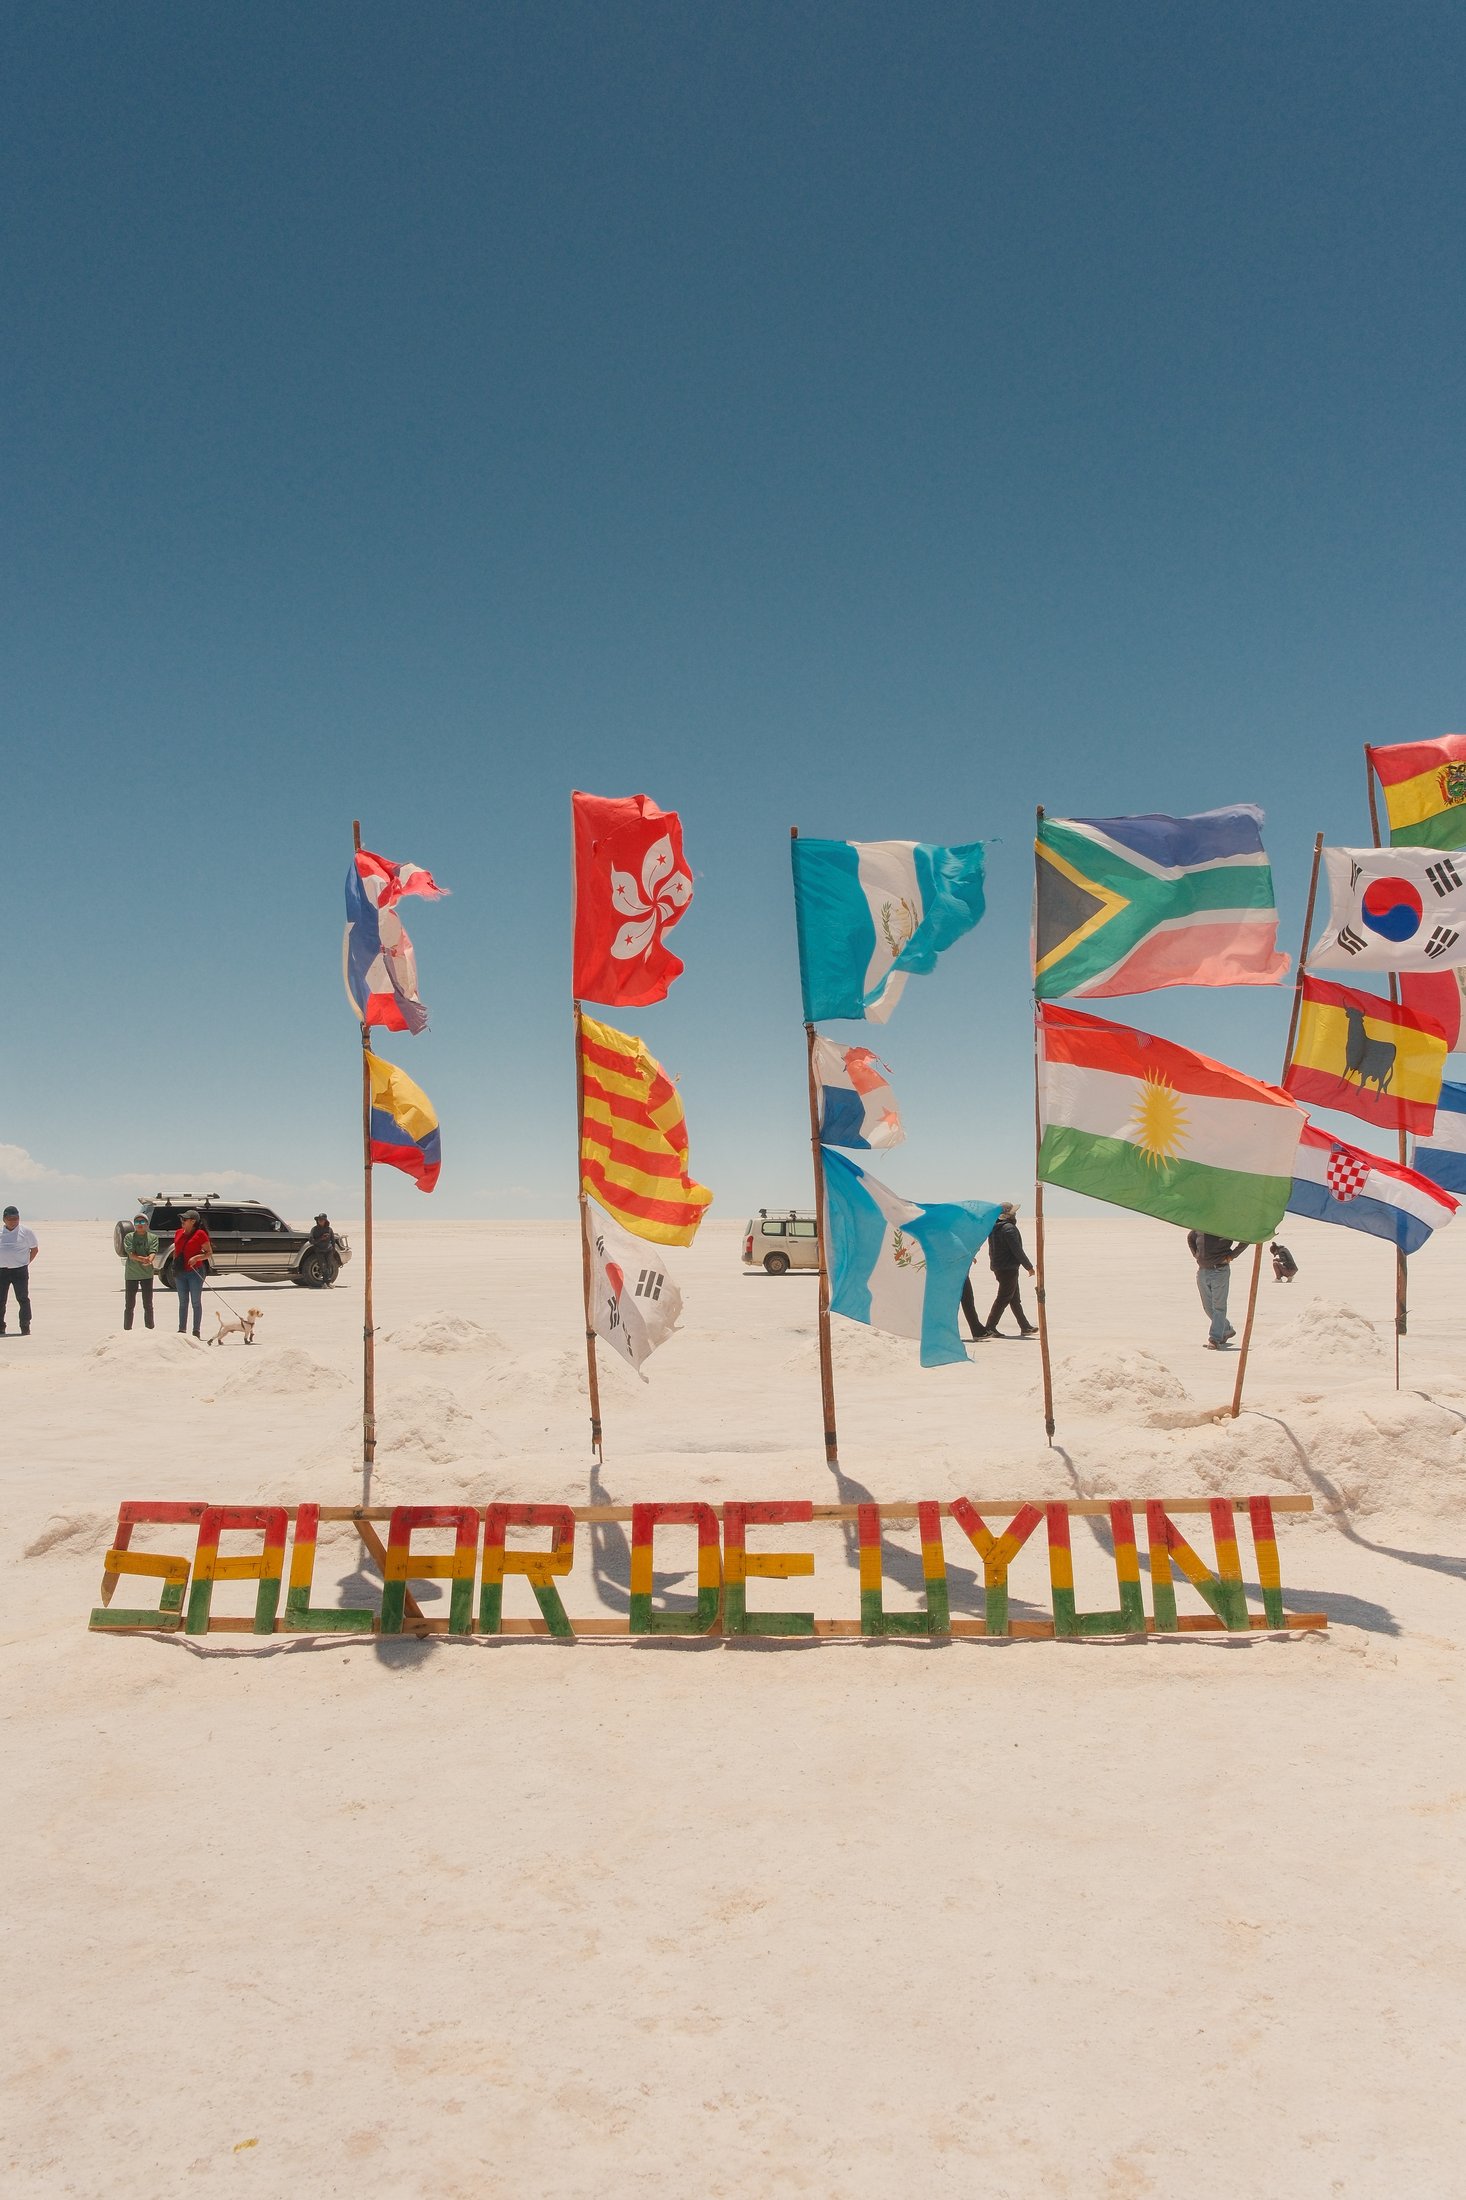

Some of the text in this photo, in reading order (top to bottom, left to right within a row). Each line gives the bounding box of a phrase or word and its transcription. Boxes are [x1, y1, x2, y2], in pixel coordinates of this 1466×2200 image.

[90, 1495, 1283, 1637] SALAR DE UYUNI
